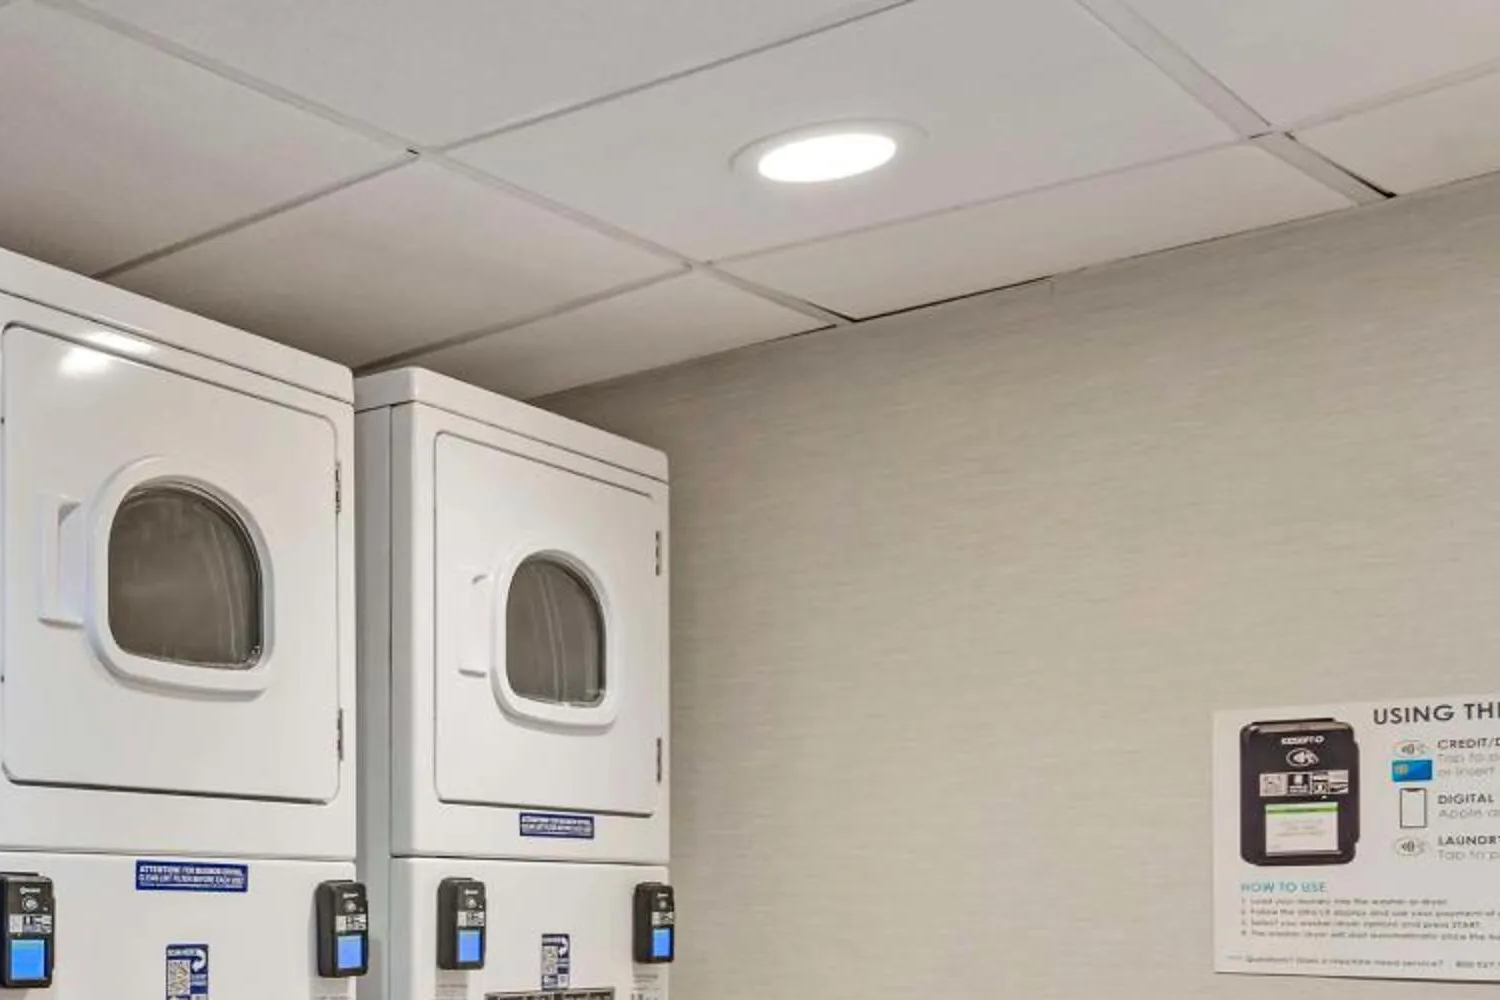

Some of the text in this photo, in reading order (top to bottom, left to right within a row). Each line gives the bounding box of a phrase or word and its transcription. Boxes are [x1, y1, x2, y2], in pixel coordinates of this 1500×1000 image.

[1373, 701, 1500, 725] USING TH
[1438, 793, 1494, 805] DIGITAL
[1241, 881, 1275, 893] HOW
[1280, 881, 1298, 893] TO
